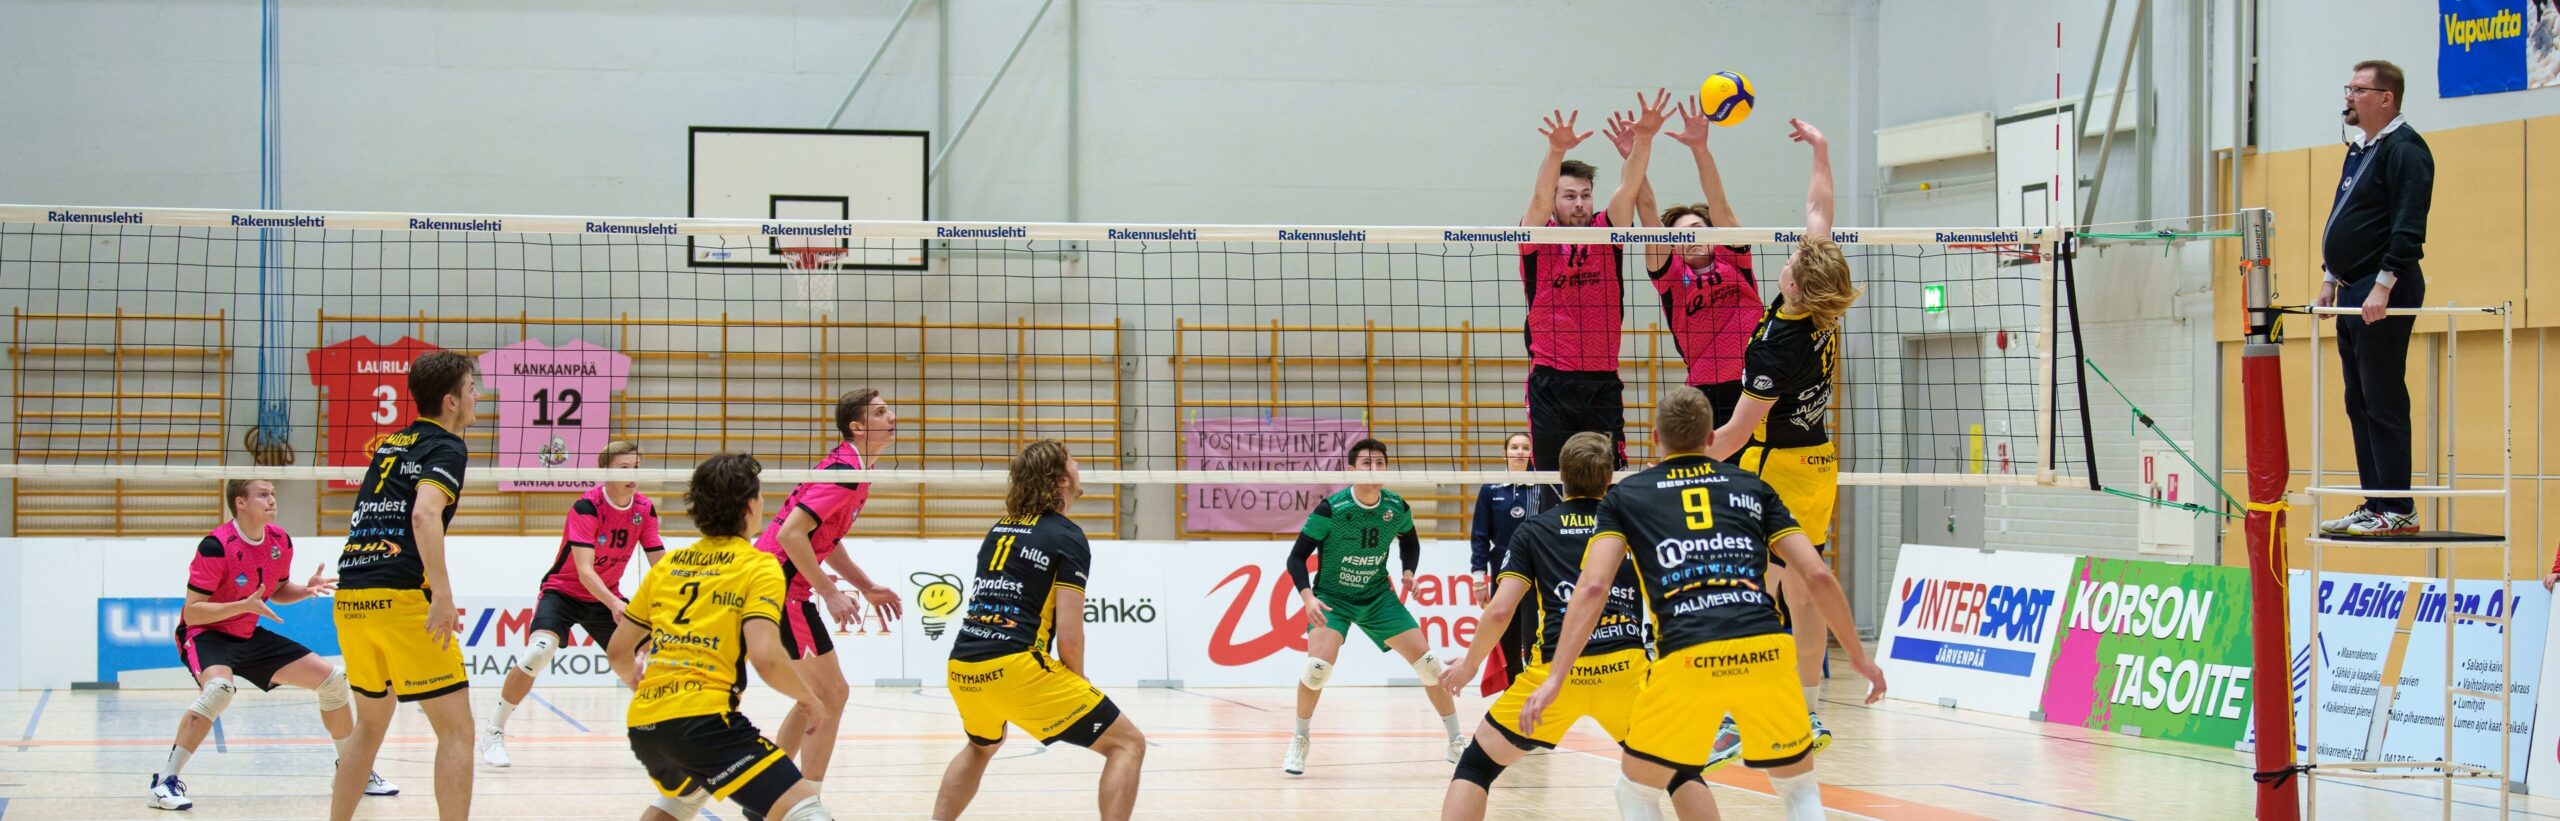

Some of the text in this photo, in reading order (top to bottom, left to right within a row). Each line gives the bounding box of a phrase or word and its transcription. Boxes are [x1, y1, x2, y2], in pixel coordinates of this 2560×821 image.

[48, 210, 143, 224] Rakennuslehti
[231, 215, 325, 228] Rakennuslehti
[409, 218, 502, 232] Rakennuslehti
[586, 221, 678, 235] Rakennuslehti
[761, 224, 852, 237] Rakennuslehti
[936, 226, 1026, 238] Rakennuslehti
[1108, 228, 1197, 240] Rakennuslehti
[1278, 229, 1366, 241] Rakennuslehti
[1444, 230, 1531, 242] Rakennuslehti
[1610, 231, 1696, 243] Rakennuslehti
[1775, 231, 1858, 243] Rakelehti
[1935, 231, 2019, 243] Rakennuslehti
[357, 361, 411, 373] LAURILA
[513, 362, 597, 376] KANKAANPÄÄ
[371, 385, 398, 425] 3
[532, 388, 583, 426] 12
[1199, 431, 1347, 453] POSITIIVINEN
[374, 455, 398, 494] 7
[1199, 488, 1310, 512] LEVOTON
[1681, 487, 1714, 531] 9
[609, 528, 628, 549] 19
[1361, 527, 1380, 549] 18
[988, 535, 1017, 571] 11
[337, 599, 393, 611] CITYMARKET
[671, 581, 700, 625] 2
[1083, 598, 1156, 623] ähkö
[1673, 591, 1764, 617] JALMERI OY
[1916, 578, 2056, 645] INTERSPORT
[2069, 580, 2214, 643] KORSON
[961, 624, 992, 639] ALMERI
[1694, 648, 1781, 668] CITYMARKET
[1935, 644, 1987, 668] JÄRVENPÄÄ
[2340, 647, 2378, 661] Maanrakennus
[1569, 660, 1631, 677] TYMARKET
[1711, 668, 1750, 678] KOKKOLA
[2335, 666, 2350, 679] Sähkö
[2349, 670, 2357, 682] ja
[2466, 659, 2503, 674] Salaoja kaivu
[951, 668, 1005, 685] CITYMARKET
[1570, 677, 1603, 686] KOKKOLA
[2110, 653, 2253, 721] TASOITE
[2348, 683, 2360, 695] sekä
[2325, 701, 2356, 716] Kaikenlaiset
[2458, 697, 2486, 713] Lumityöt
[2454, 716, 2475, 729] Lumen
[2475, 718, 2488, 733] ajot
